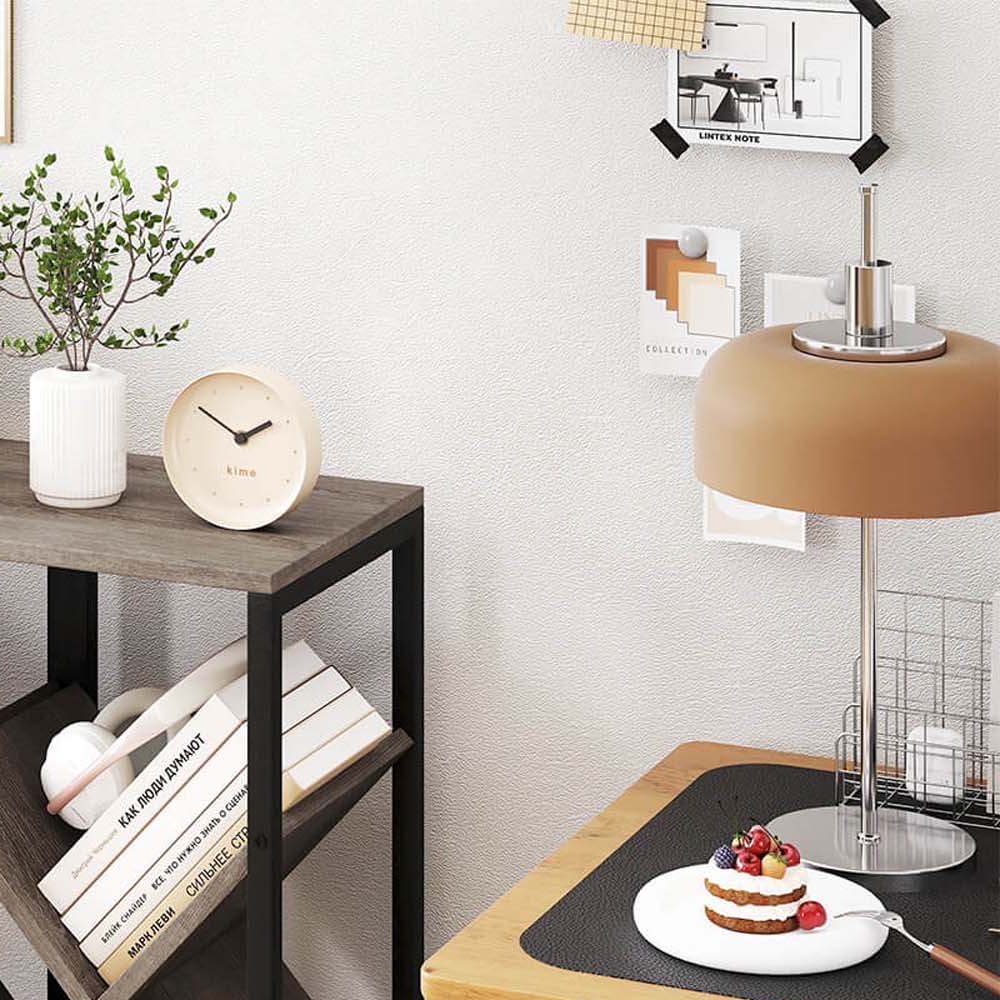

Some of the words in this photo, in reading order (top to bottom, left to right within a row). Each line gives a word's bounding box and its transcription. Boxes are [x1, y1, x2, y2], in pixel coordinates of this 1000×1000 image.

[699, 132, 732, 141] LINTEX
[734, 135, 760, 143] NOTE
[118, 804, 144, 829] КАК
[139, 776, 168, 808] ЛЮДИ
[164, 732, 206, 782] ДУМАЮТ
[164, 860, 181, 877] ЧТО
[199, 817, 223, 841] ЗНАТЬ
[127, 926, 154, 960] МАРК
[148, 906, 176, 940] ЛЕВИ
[185, 847, 232, 897] СИЛЬНЕЕ
